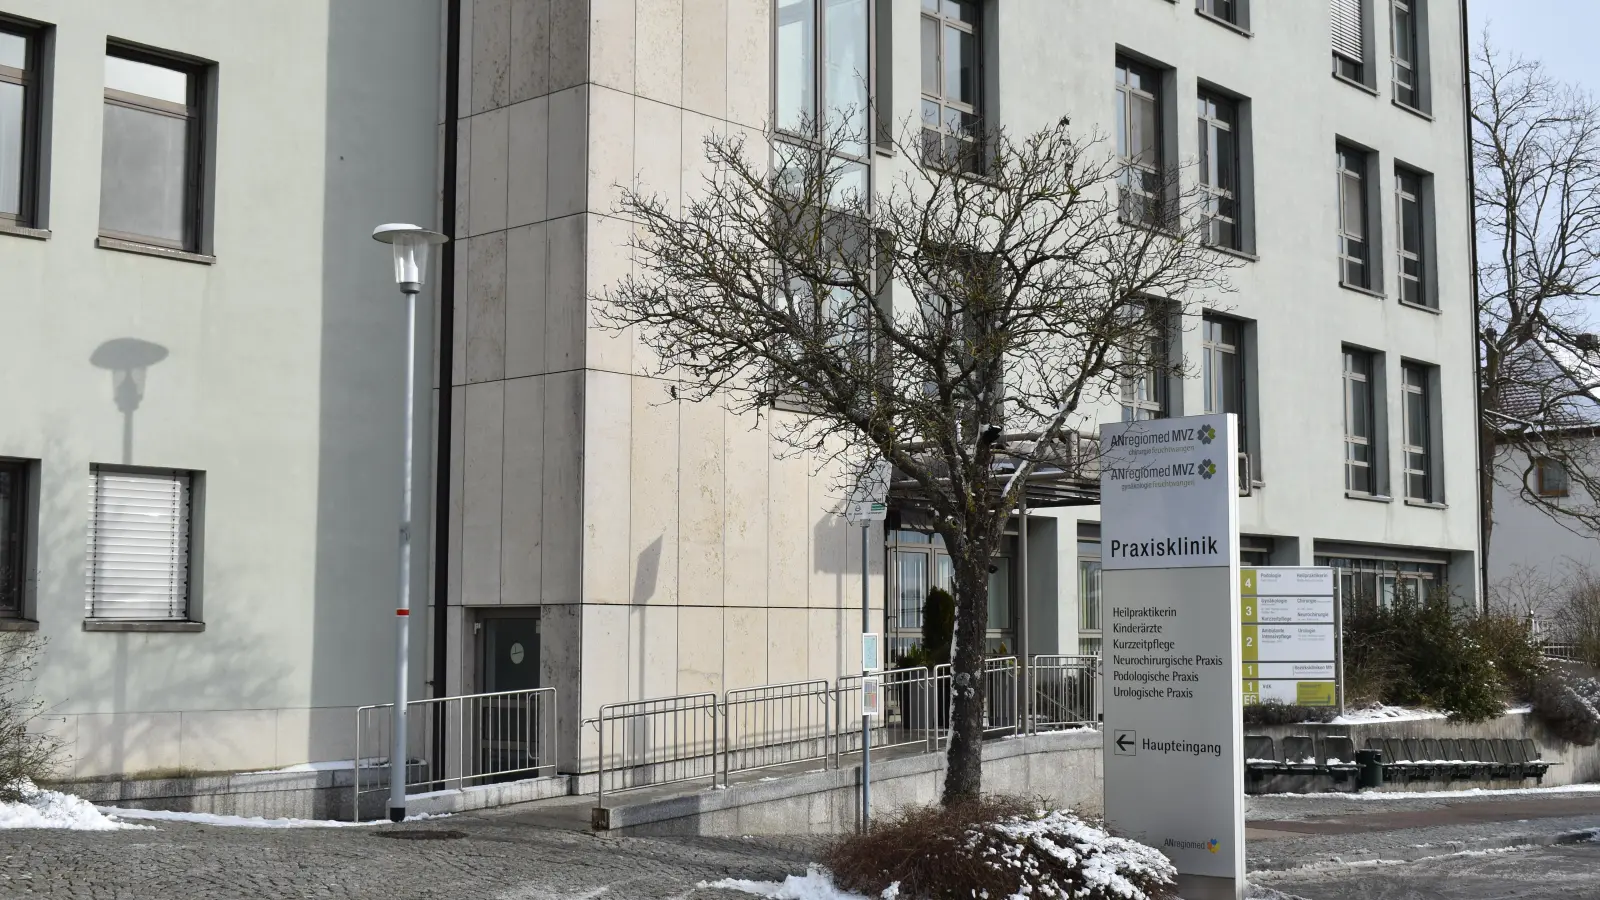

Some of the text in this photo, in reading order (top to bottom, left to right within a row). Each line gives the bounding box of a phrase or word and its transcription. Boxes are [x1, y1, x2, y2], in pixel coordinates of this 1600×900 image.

[1110, 429, 1194, 447] ANregiomed MVZ
[1110, 463, 1194, 481] ANregiomed MVZ
[1111, 536, 1218, 558] Praxisklinik
[1244, 578, 1252, 588] 4
[1113, 606, 1177, 621] Heilpraktikerin
[1245, 606, 1252, 616] 3
[1113, 623, 1163, 634] Kinderärzte
[1113, 638, 1176, 652] Kurzzeitpflege
[1246, 637, 1253, 647] 2
[1113, 655, 1223, 668] Neurochirurgische Praxis
[1247, 665, 1253, 675] 1
[1113, 671, 1199, 684] Podologische Praxis
[1113, 686, 1193, 700] Urologische Praxis
[1247, 682, 1253, 691] 1
[1244, 695, 1257, 705] EG
[1142, 738, 1221, 757] Haupteingang
[1164, 838, 1205, 849] ANregiomed
